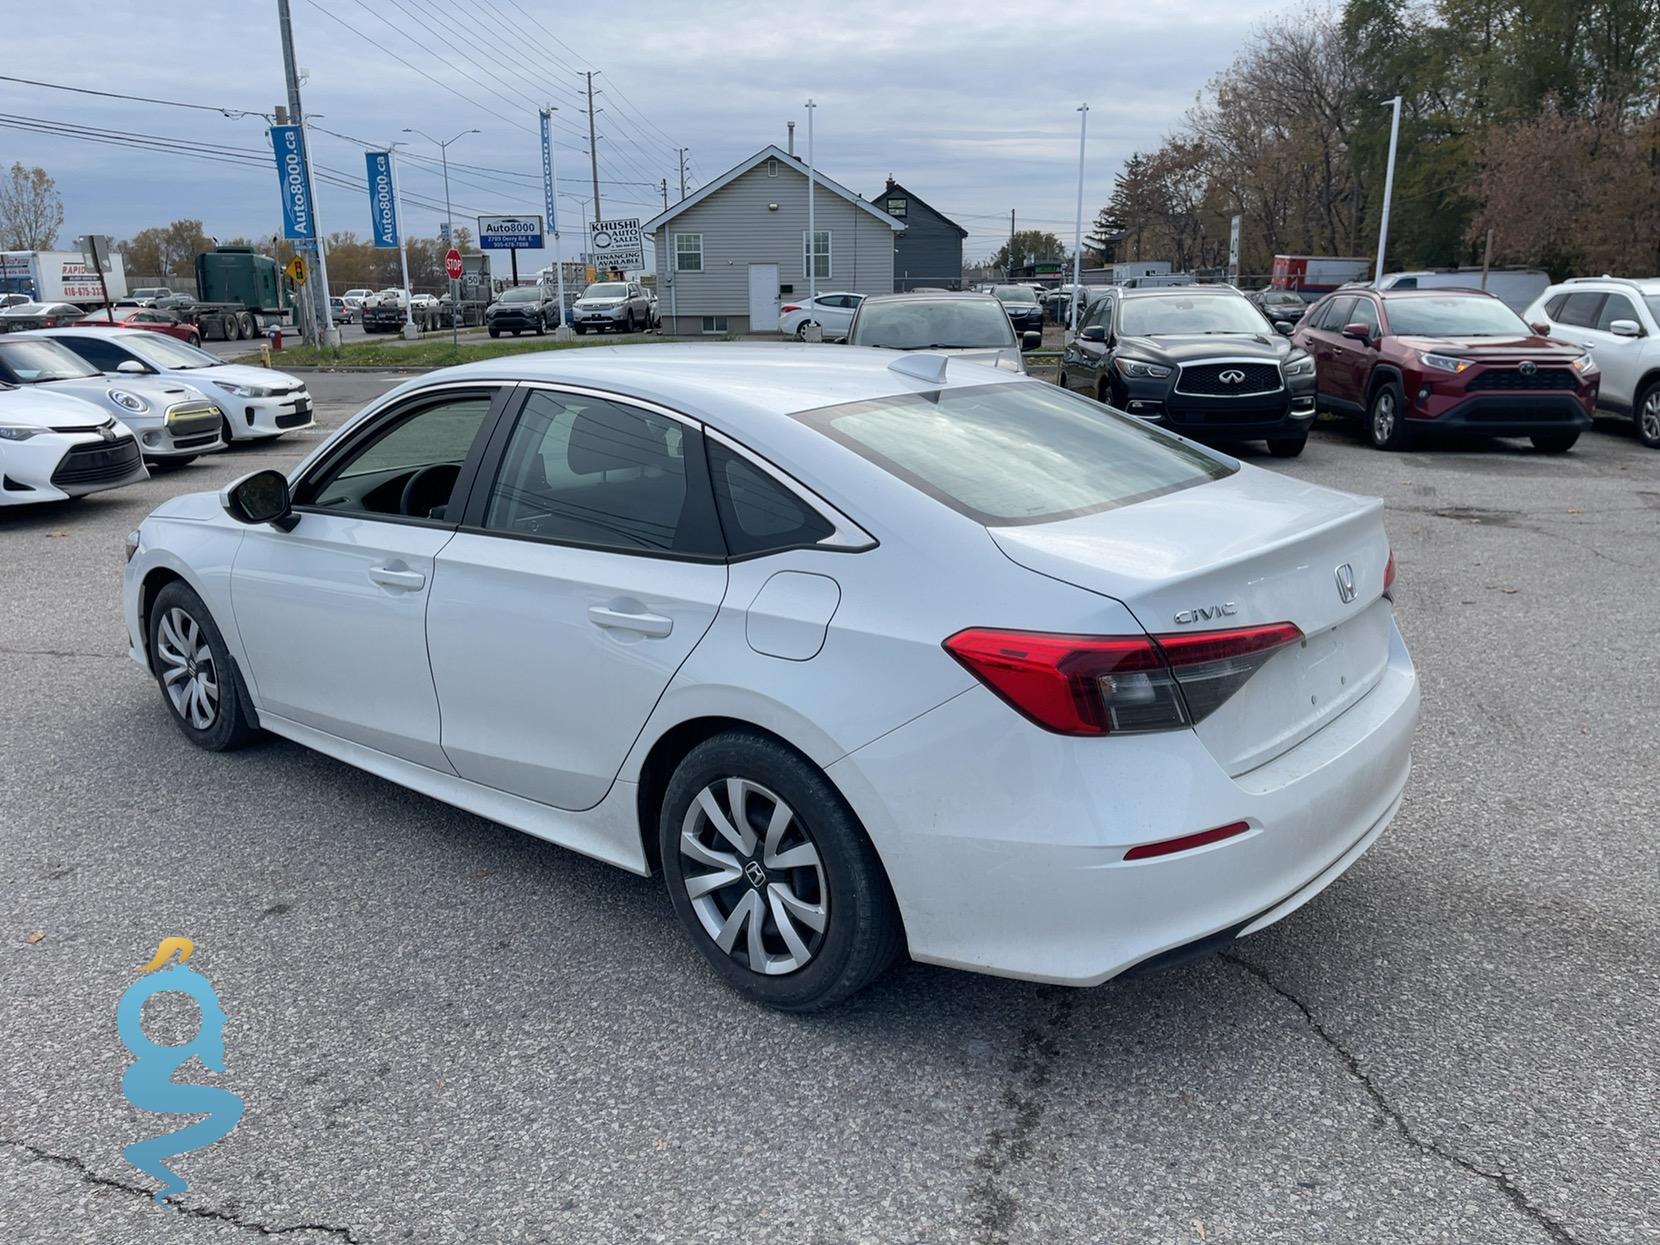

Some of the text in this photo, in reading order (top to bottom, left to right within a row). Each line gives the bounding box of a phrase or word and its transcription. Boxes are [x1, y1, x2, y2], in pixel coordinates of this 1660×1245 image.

[284, 131, 307, 234] Auto8000.ca
[376, 156, 393, 243] Auto8000.ca
[486, 223, 535, 233] Auto8000
[592, 220, 637, 231] KHUSHI
[612, 229, 638, 237] AUTO
[596, 252, 640, 261] FINANCING
[446, 258, 461, 271] STOP
[598, 258, 639, 267] AVAILABLE
[468, 275, 478, 284] 50
[64, 286, 105, 297] 416-675-333
[1174, 601, 1238, 624] CIVIC
